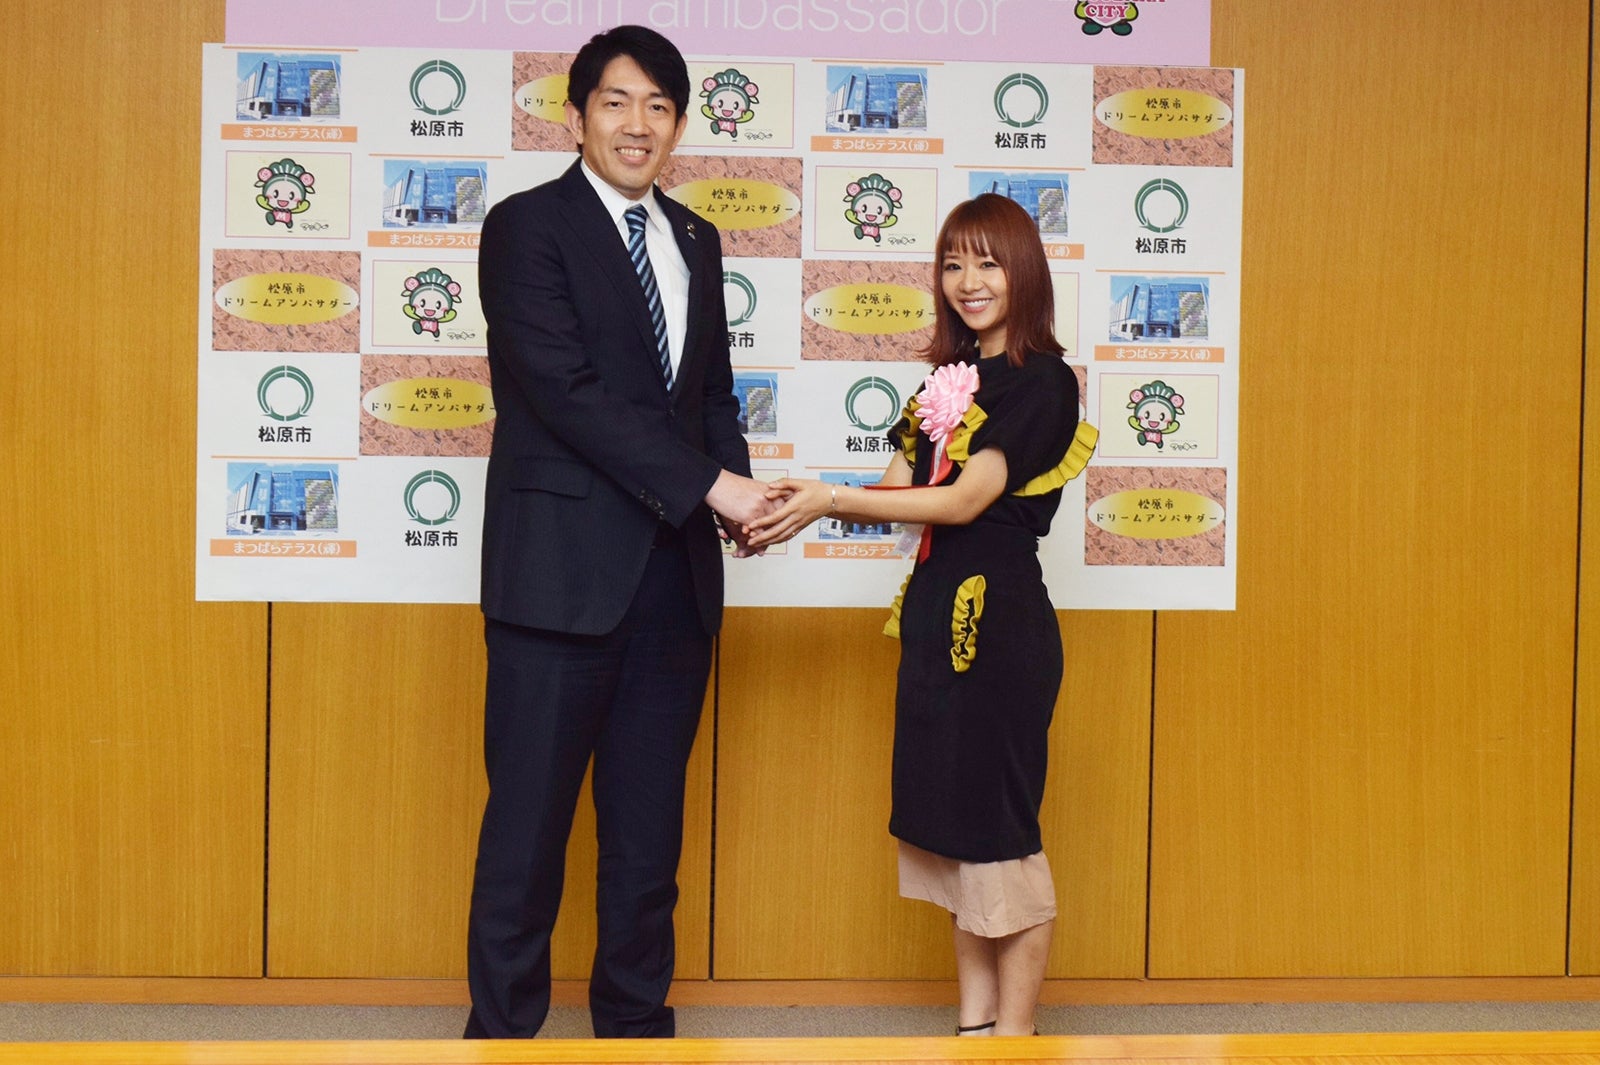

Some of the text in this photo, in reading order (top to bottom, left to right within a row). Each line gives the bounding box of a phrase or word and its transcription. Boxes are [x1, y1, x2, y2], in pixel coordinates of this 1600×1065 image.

[648, 0, 1008, 36] ambassador
[1085, 5, 1129, 18] CITY
[1145, 97, 1183, 110] 松原市
[1104, 111, 1227, 124] ドリームアンバサダー
[410, 119, 464, 137] 松原市
[994, 131, 1046, 149] 松原市
[711, 188, 749, 201] 松原市
[1135, 237, 1187, 254] 松原市
[268, 282, 306, 296] 松原市
[223, 297, 352, 309] ドリームアンバサダー
[855, 292, 893, 305] 松原市
[415, 387, 453, 400] 松原市
[258, 426, 312, 443] 松原市
[1137, 498, 1176, 511] 松原市
[1096, 513, 1219, 524] ドリームアンバサダー
[405, 530, 459, 547] 松原市
